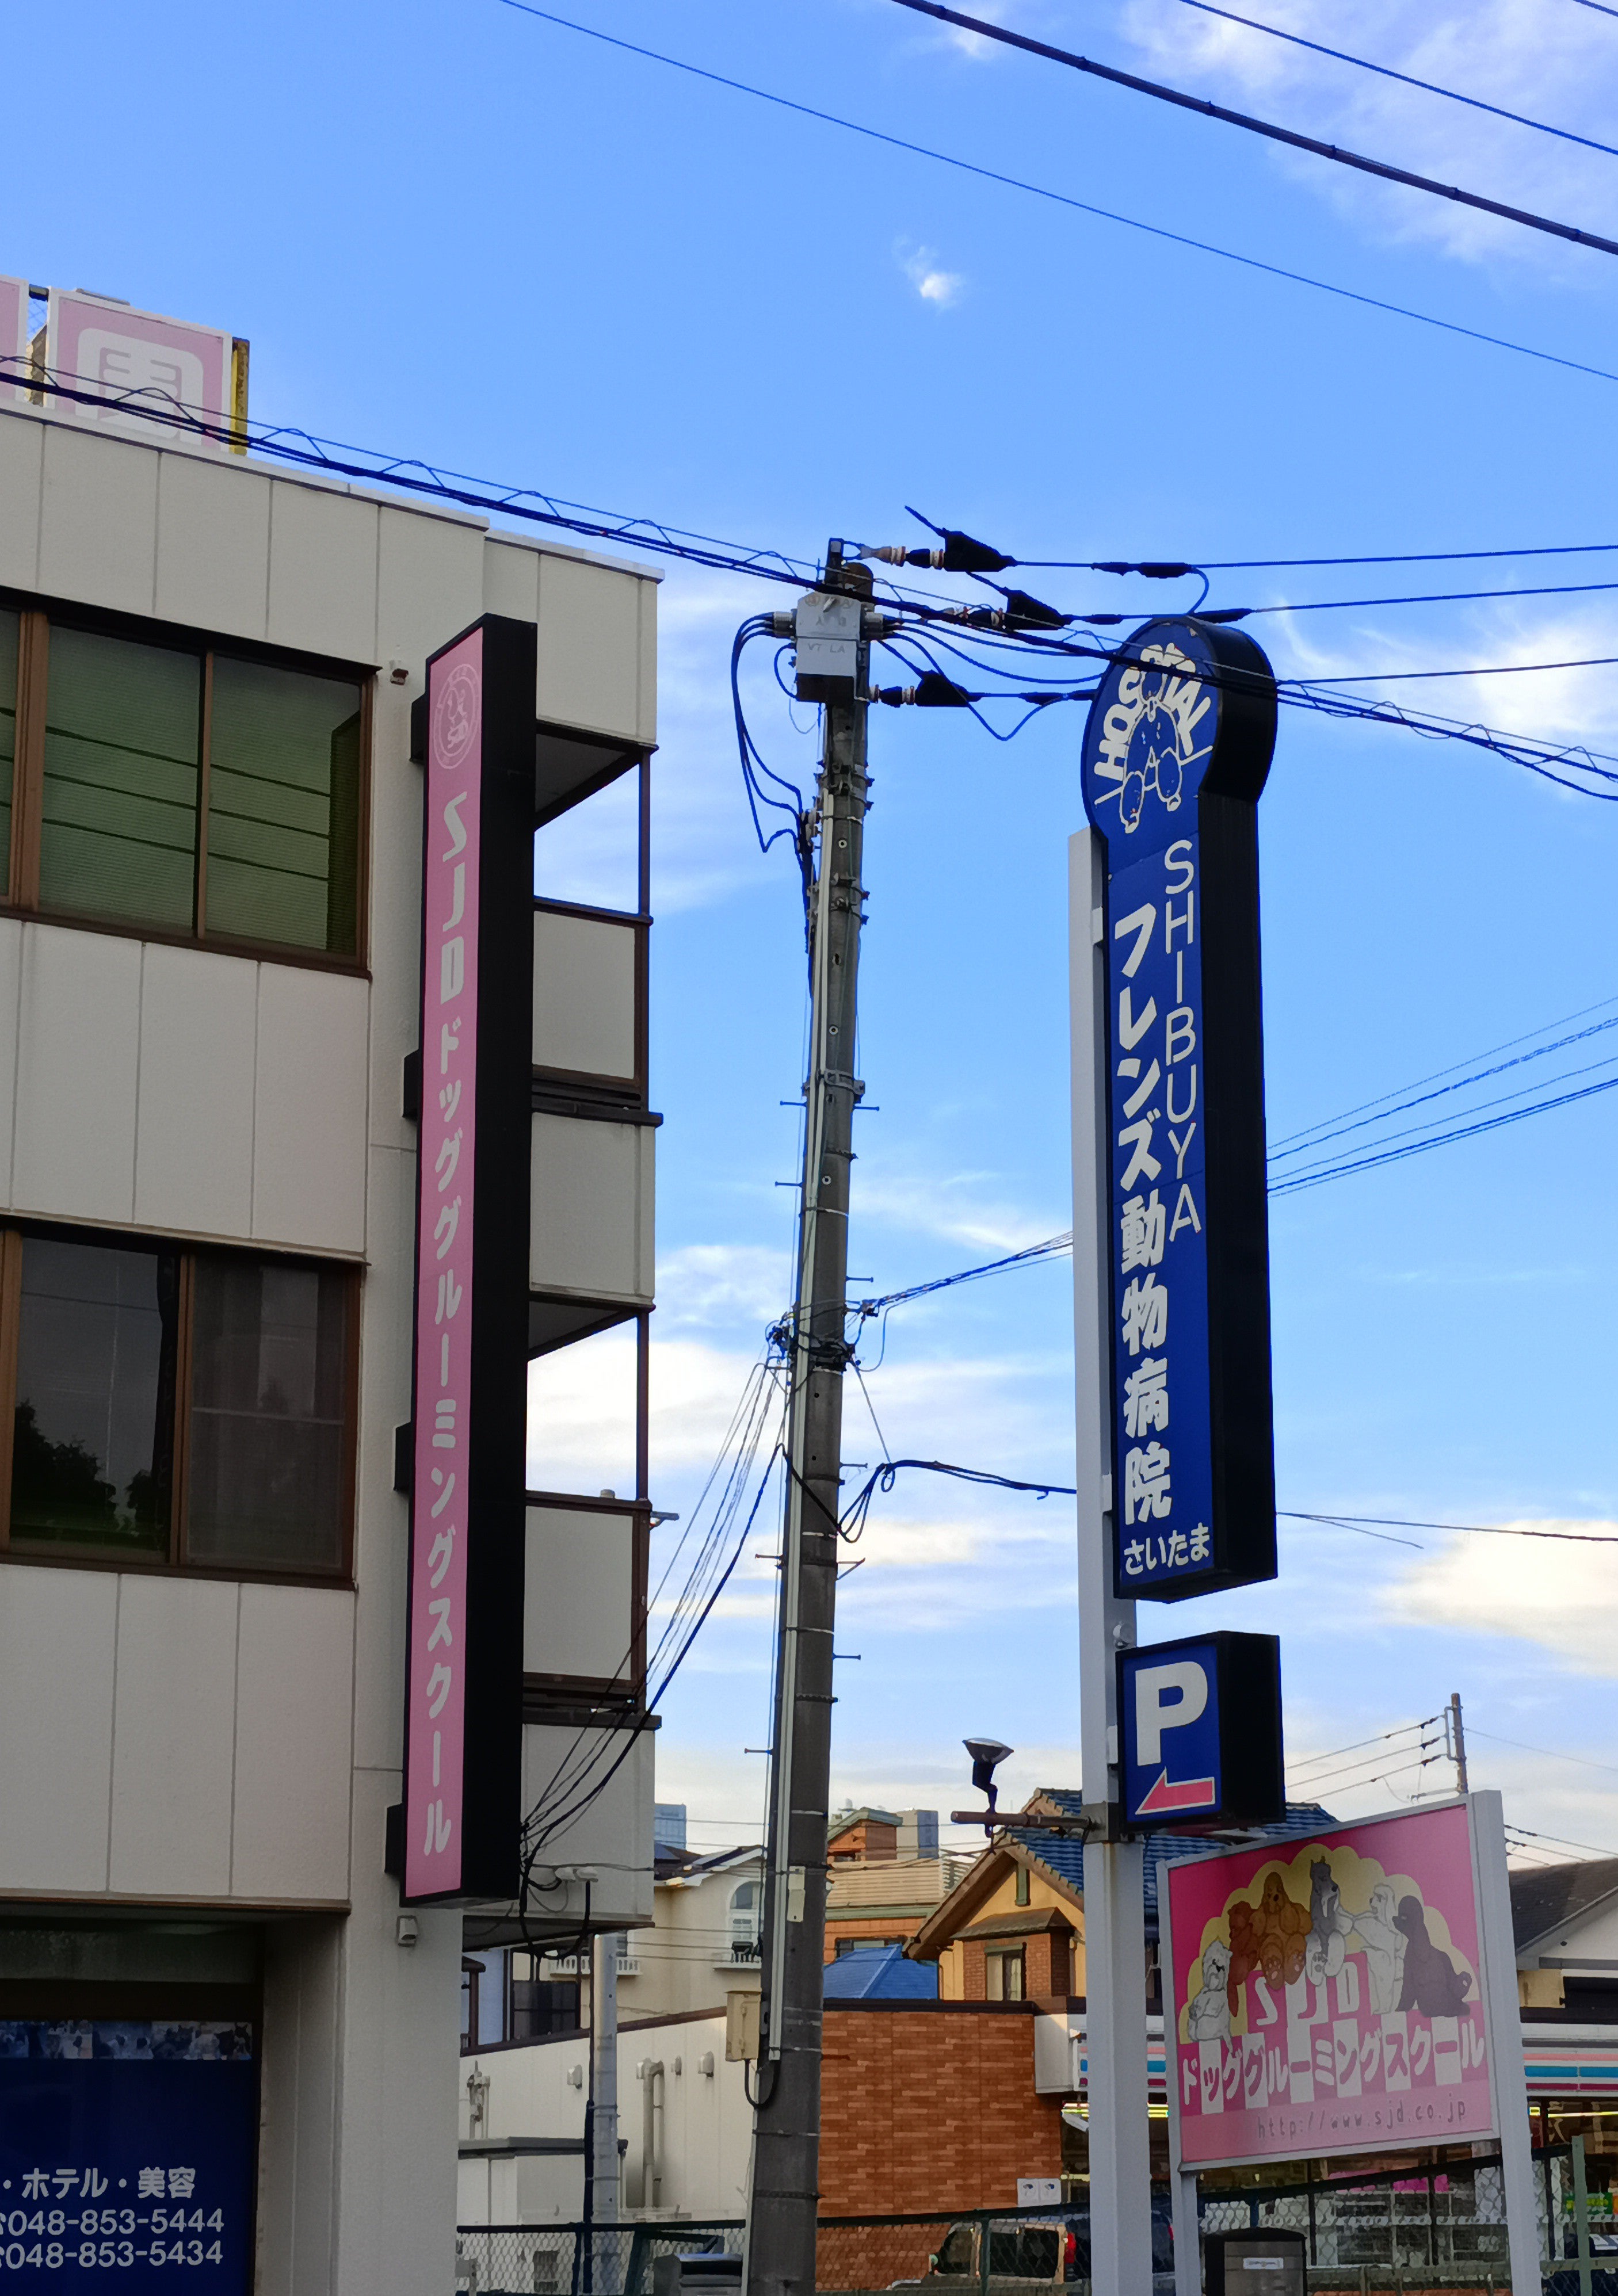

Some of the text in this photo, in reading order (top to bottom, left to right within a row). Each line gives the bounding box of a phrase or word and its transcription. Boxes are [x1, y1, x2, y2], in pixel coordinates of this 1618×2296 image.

[1165, 839, 1201, 1241] SHIBUYA
[1115, 903, 1171, 1525] フレンズ動物病院
[1124, 1522, 1209, 1575] さいたま
[1135, 1661, 1208, 1766] P
[1183, 2019, 1485, 2106] ドッググルーミングスクール
[1258, 2092, 1466, 2139] http://www.sjd.co.jp
[6, 2240, 223, 2269] 048-853-5434
[8, 2208, 224, 2236] 048-853-5444
